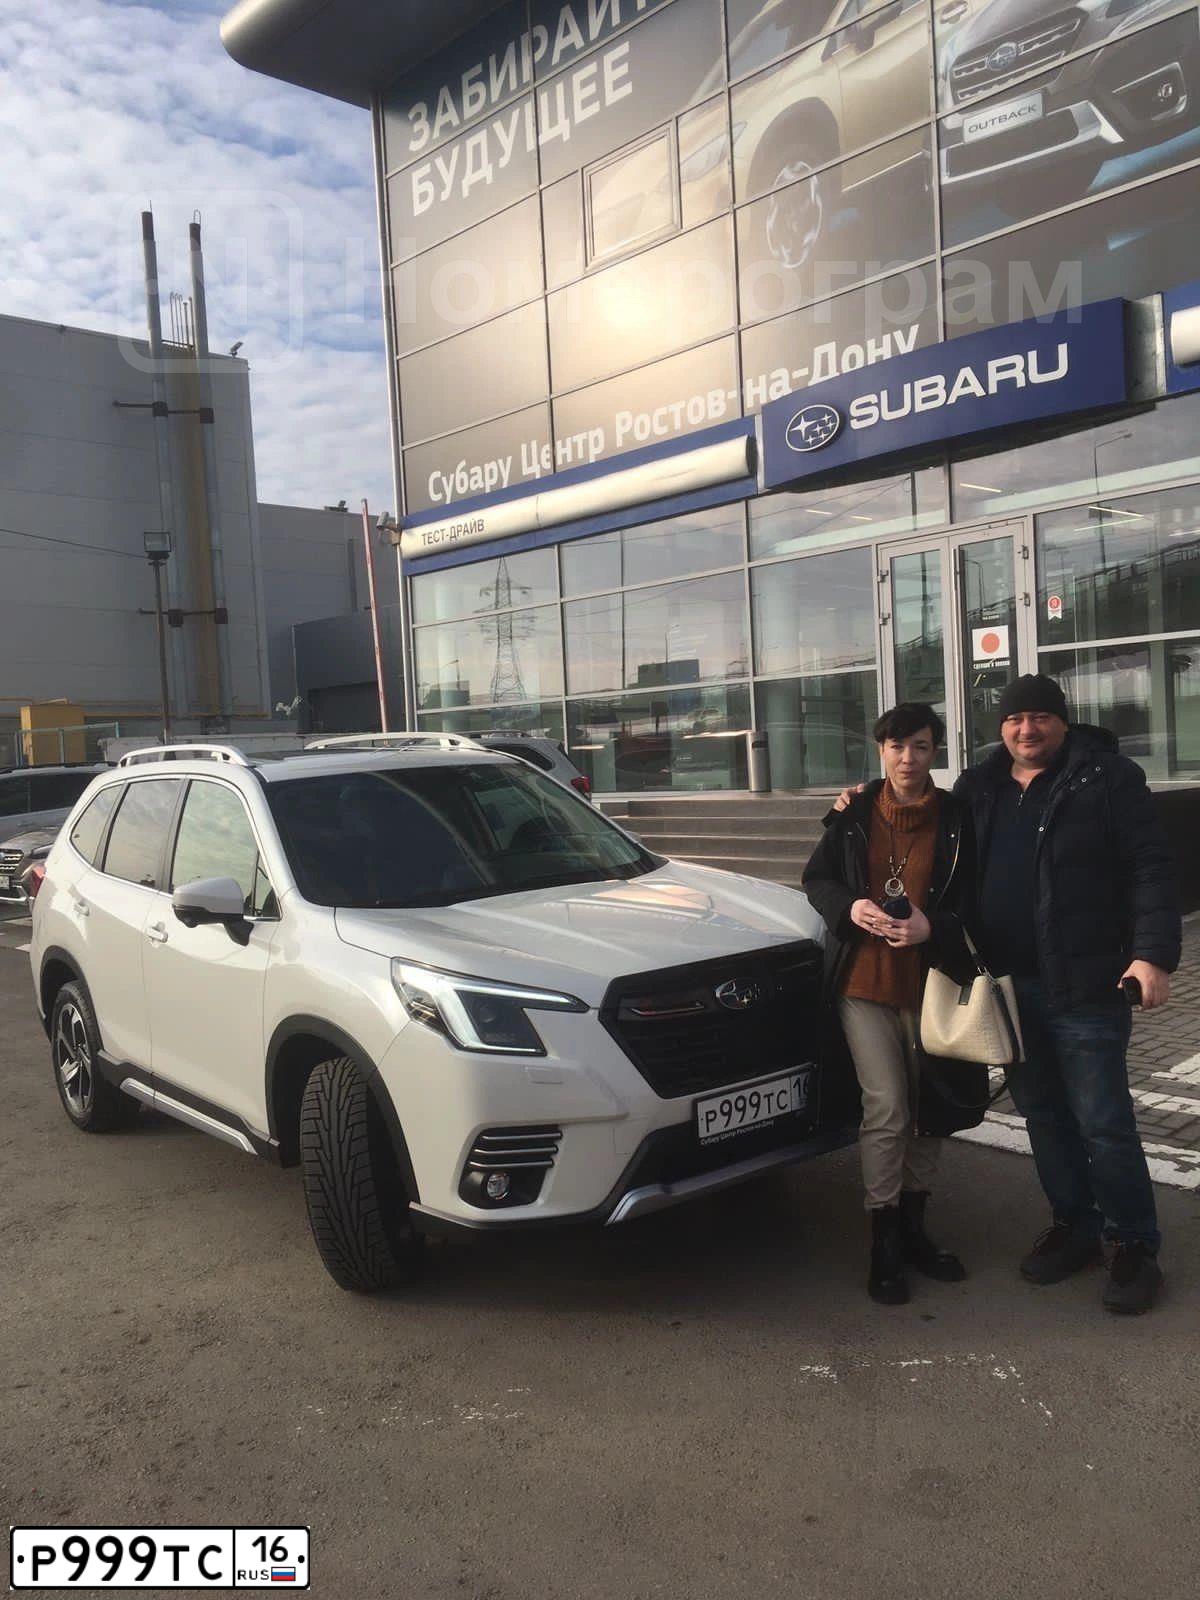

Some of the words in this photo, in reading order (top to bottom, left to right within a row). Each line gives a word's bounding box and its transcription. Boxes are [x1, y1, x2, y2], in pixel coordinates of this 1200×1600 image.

[411, 41, 633, 217] БУДУЩЕЕ
[968, 103, 1038, 133] OUTBACK
[850, 343, 1068, 430] SUBARU
[428, 453, 513, 503] Субару
[521, 426, 605, 478] Центр
[421, 518, 485, 546] ТЕСТ-ДРАЙВ
